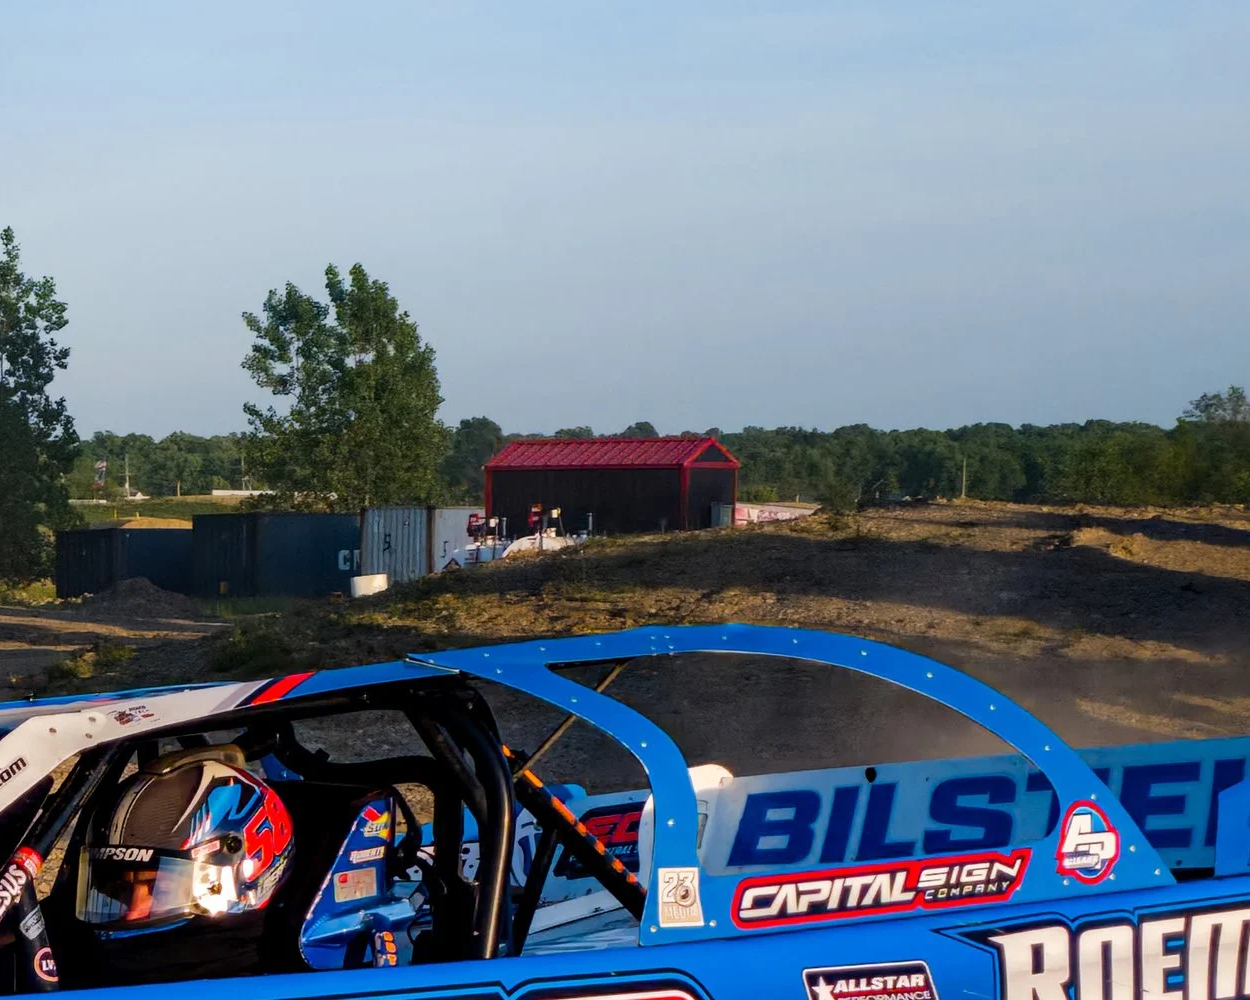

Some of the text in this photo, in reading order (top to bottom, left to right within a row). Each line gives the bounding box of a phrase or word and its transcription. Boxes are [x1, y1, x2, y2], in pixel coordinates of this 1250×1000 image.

[243, 788, 293, 882] 58
[918, 858, 1022, 888] SIGN
[739, 870, 917, 920] CAPITAL
[924, 881, 1011, 900] COMPANY
[833, 973, 926, 994] ALLSTAR
